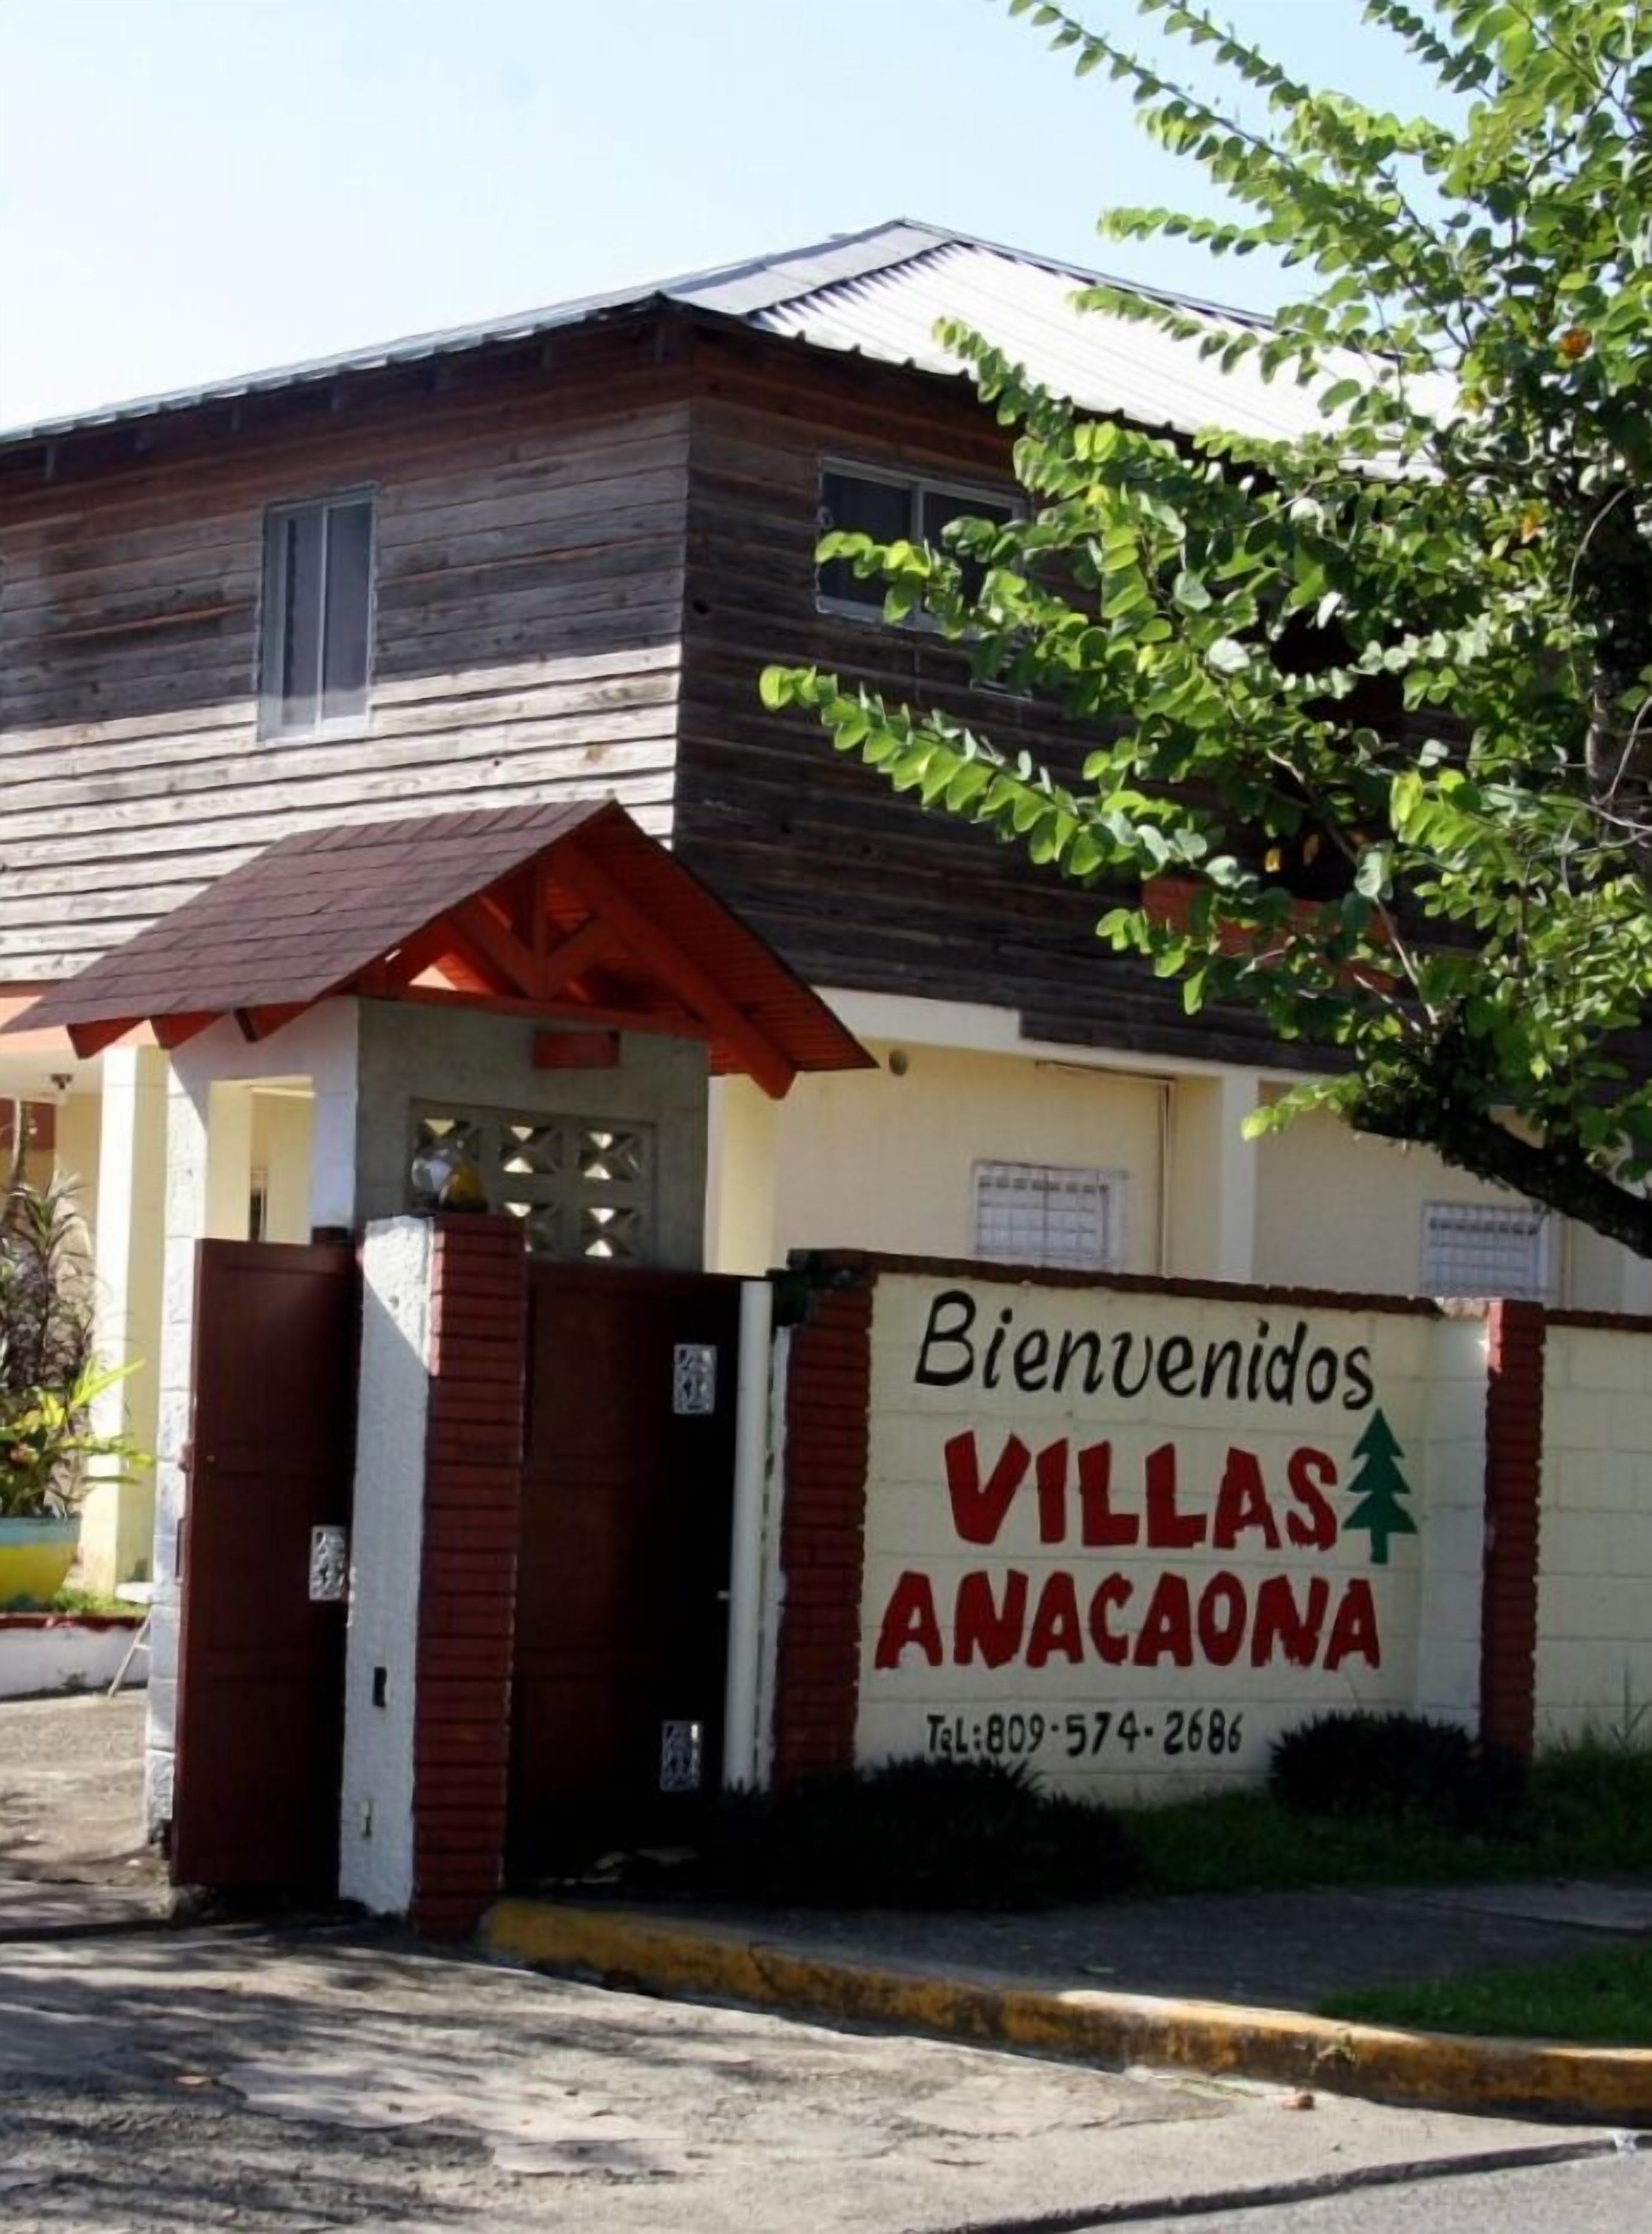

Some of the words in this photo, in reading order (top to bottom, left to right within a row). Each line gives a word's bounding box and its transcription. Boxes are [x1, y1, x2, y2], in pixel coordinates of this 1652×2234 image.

[914, 1289, 1375, 1410] Bienvenidos
[944, 1429, 1339, 1552] VILLAS
[874, 1568, 1381, 1671] ANACAONA
